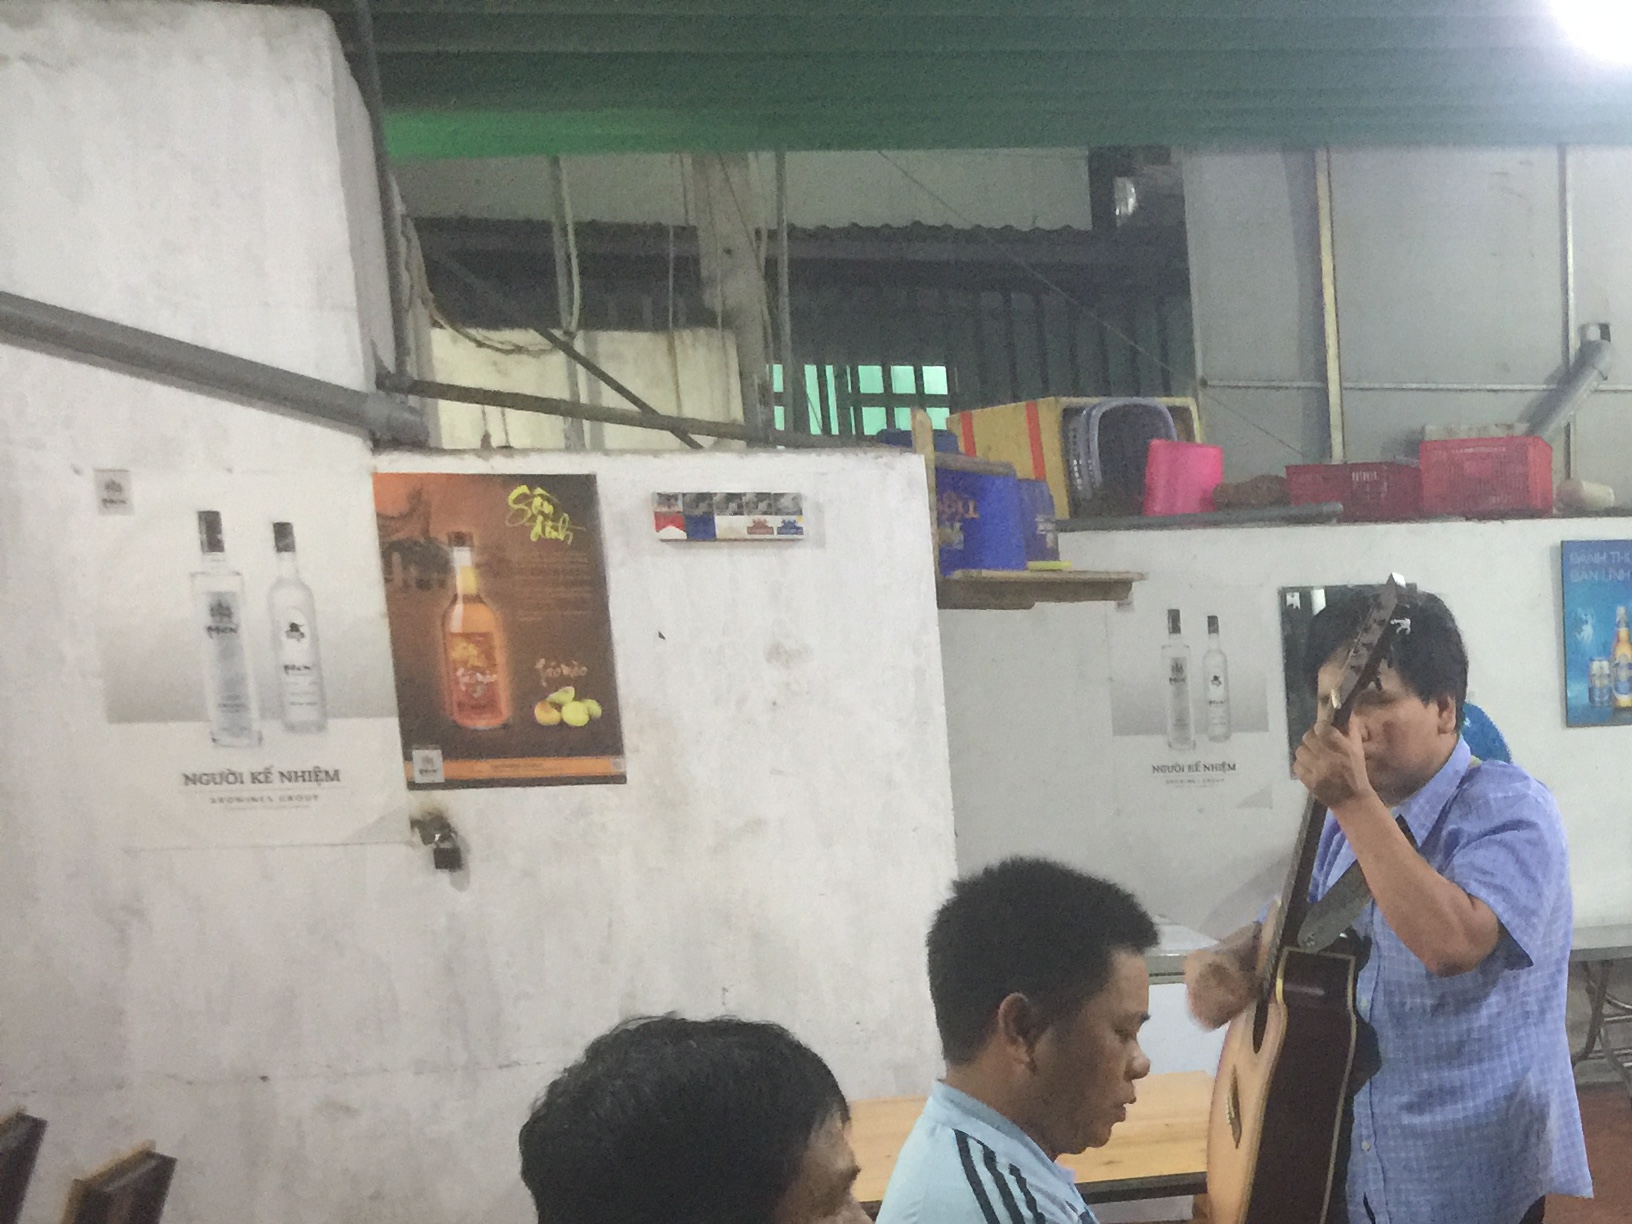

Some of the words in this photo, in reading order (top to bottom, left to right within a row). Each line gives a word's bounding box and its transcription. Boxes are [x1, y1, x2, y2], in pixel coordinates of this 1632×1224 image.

[183, 767, 245, 787] NGƯỜI
[250, 764, 274, 785] KẾ
[278, 765, 341, 787] NHIỆM
